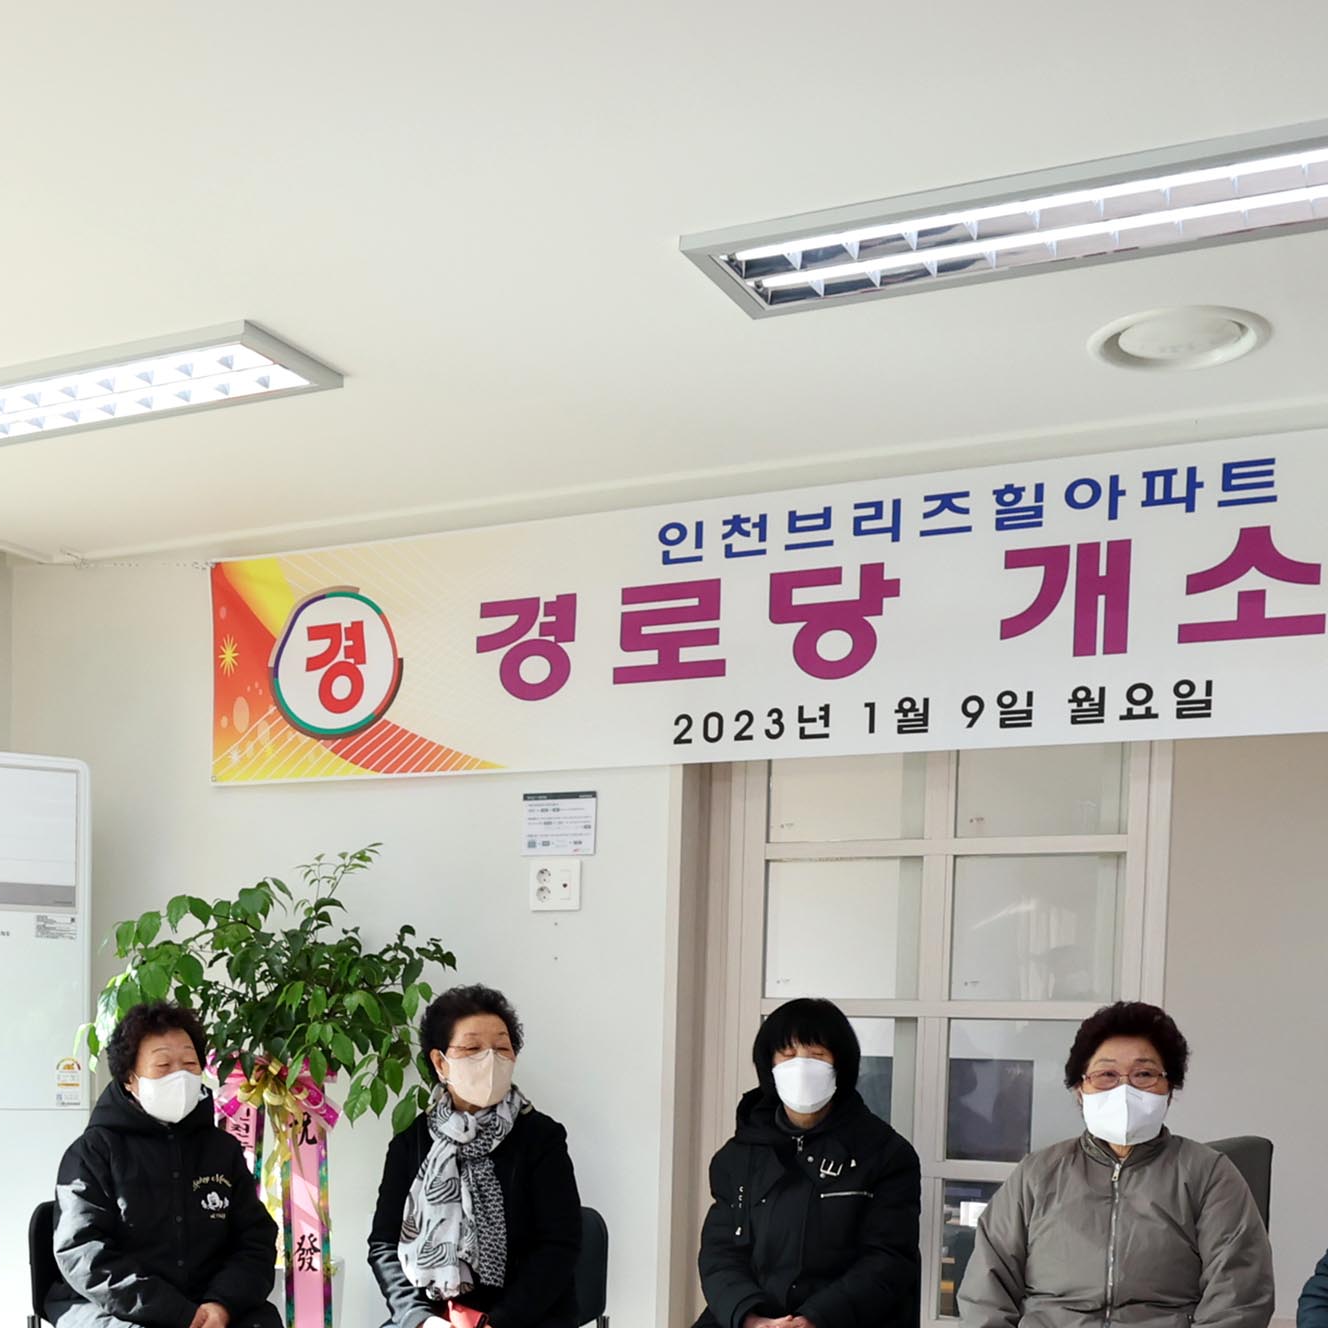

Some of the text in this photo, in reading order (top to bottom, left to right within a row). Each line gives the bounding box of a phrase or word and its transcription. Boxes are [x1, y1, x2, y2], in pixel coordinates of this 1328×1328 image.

[659, 458, 1277, 565] 인천브리즈힐아파트
[305, 620, 366, 714] 경
[477, 563, 900, 701] 경로당
[673, 679, 1213, 745] 2023년 1월 9일 월요일
